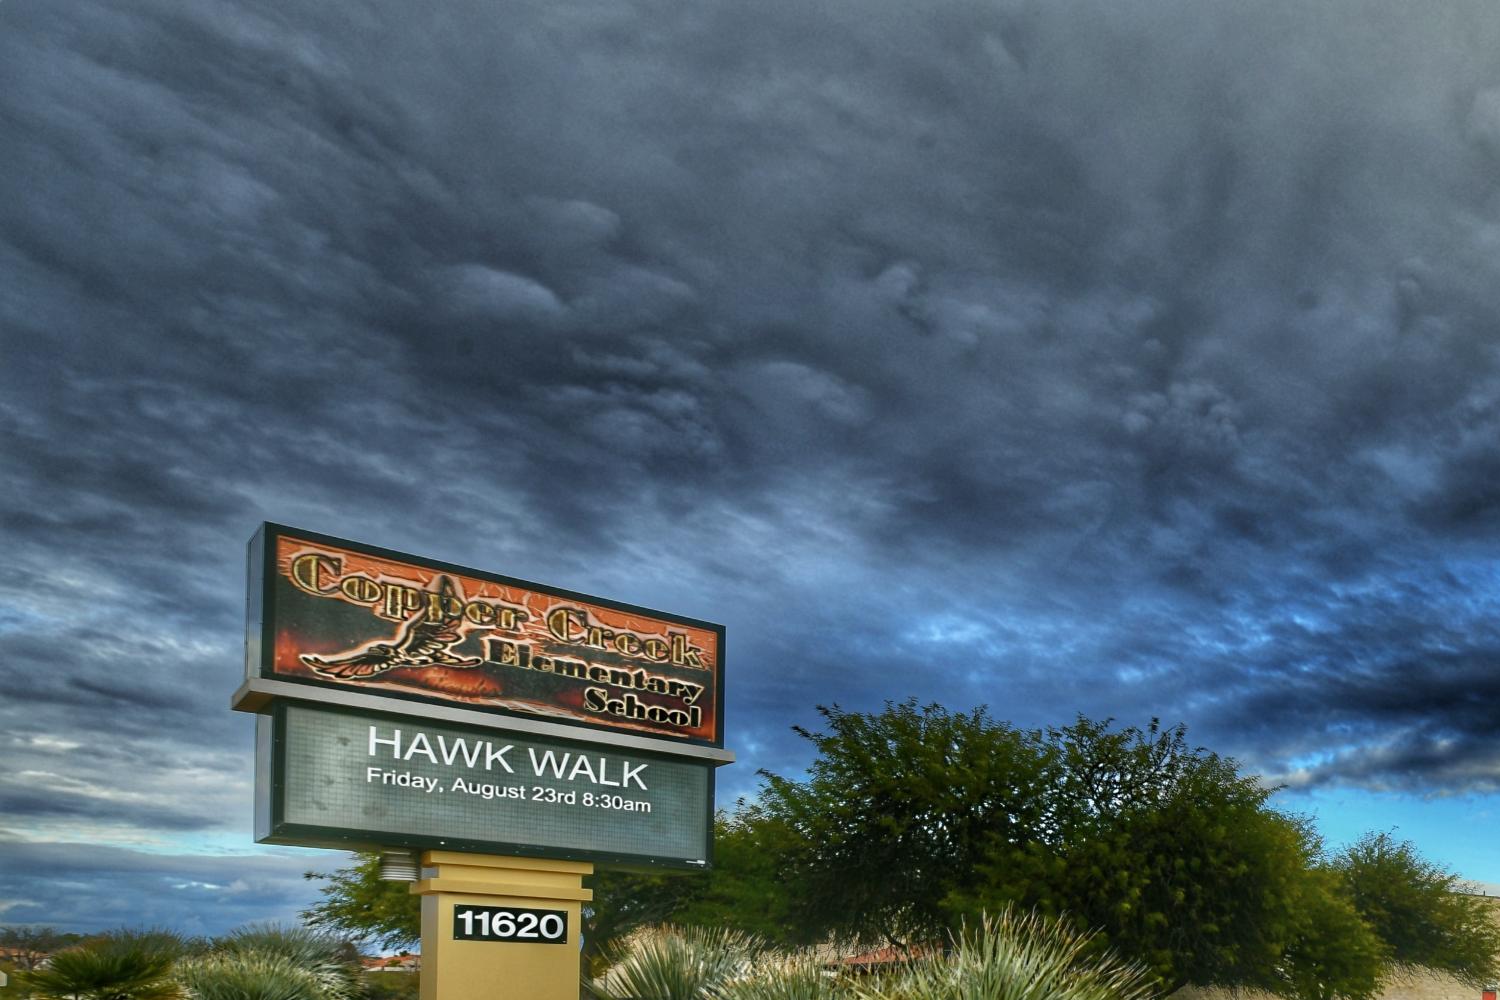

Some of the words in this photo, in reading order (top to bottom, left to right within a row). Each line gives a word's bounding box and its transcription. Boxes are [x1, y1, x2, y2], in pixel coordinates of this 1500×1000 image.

[292, 553, 529, 630] Copper
[547, 606, 707, 668] Creek
[487, 638, 705, 705] Elementary
[584, 686, 702, 728] School
[368, 725, 516, 774] HAWK
[528, 747, 649, 791] WALK
[367, 766, 444, 793] Friday,
[450, 777, 526, 800] August
[532, 786, 576, 805] 23rd
[582, 792, 652, 813] 8:30am
[457, 910, 564, 939] 11620
